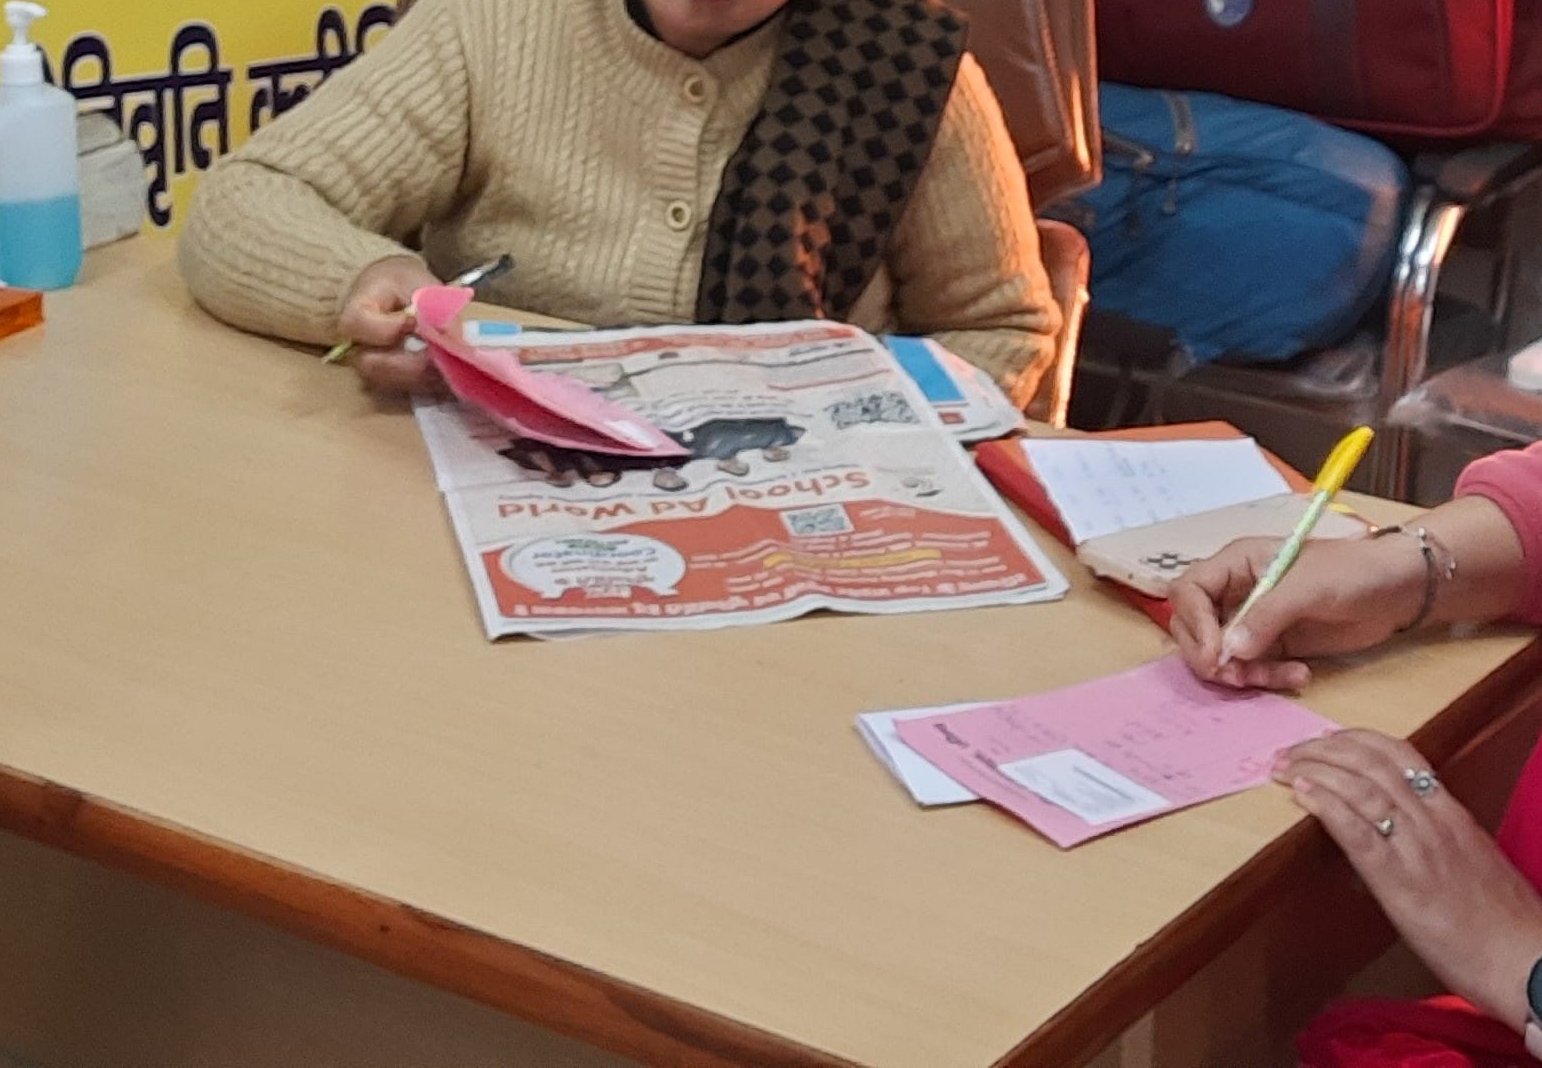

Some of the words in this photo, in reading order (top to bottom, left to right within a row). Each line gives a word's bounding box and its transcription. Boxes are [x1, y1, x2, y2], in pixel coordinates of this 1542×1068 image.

[723, 471, 871, 501] School
[497, 502, 636, 520] World
[651, 498, 709, 514] Ad
